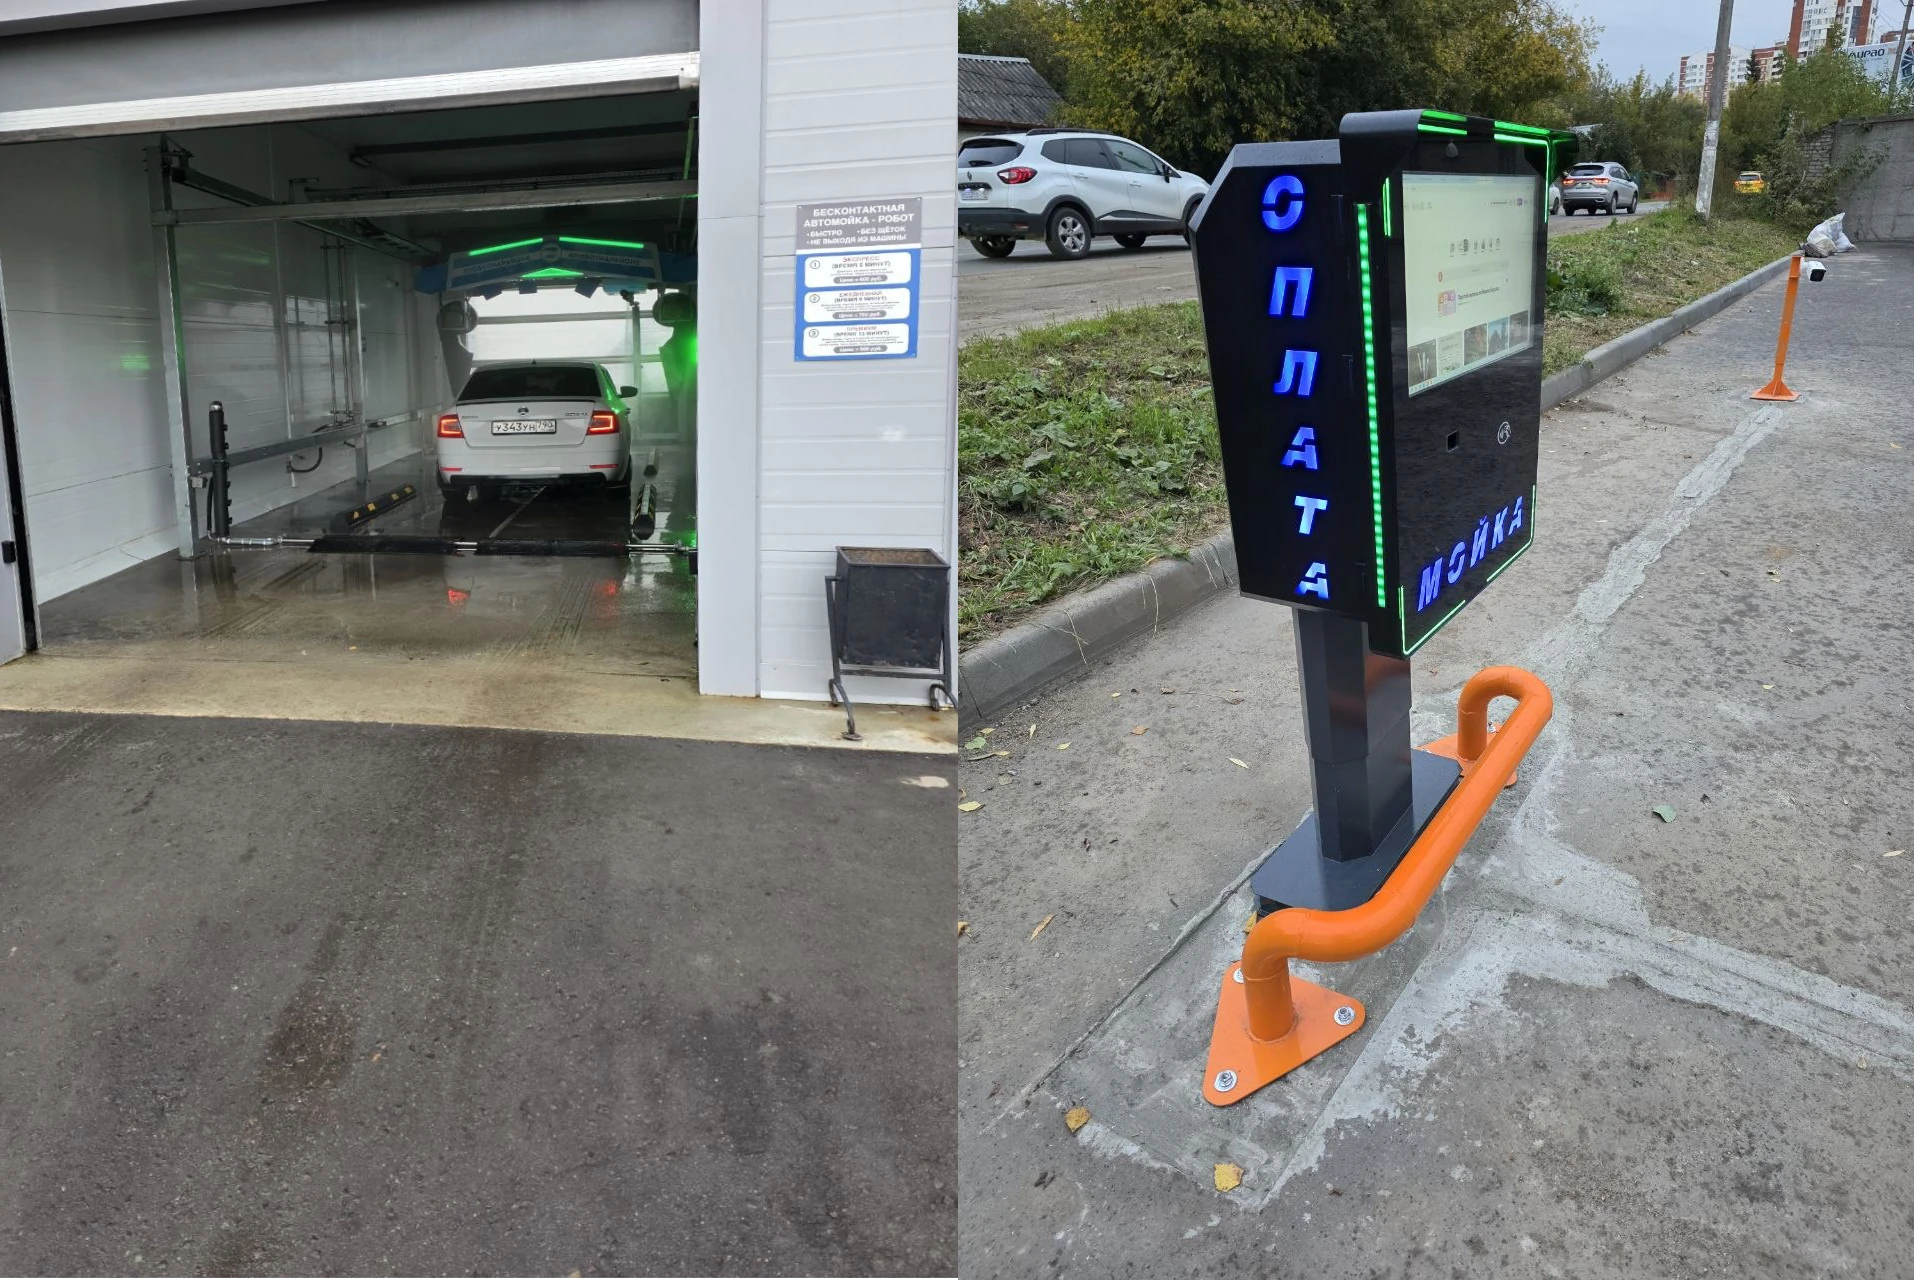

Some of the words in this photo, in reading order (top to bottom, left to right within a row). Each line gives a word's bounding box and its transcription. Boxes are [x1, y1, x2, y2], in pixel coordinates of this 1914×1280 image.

[813, 203, 905, 217] БЕСКОНТАКТНАЯ
[803, 215, 870, 228] АВТОМОЙКА
[878, 213, 915, 223] РОБОТ
[860, 227, 876, 235] БЕЗ
[822, 236, 856, 245] ВЫХОДЯ
[858, 235, 867, 243] ИЗ
[869, 234, 907, 242] МАШИНЫ
[1261, 174, 1330, 599] ОПЛАТА
[1417, 495, 1523, 612] МОЙКА
